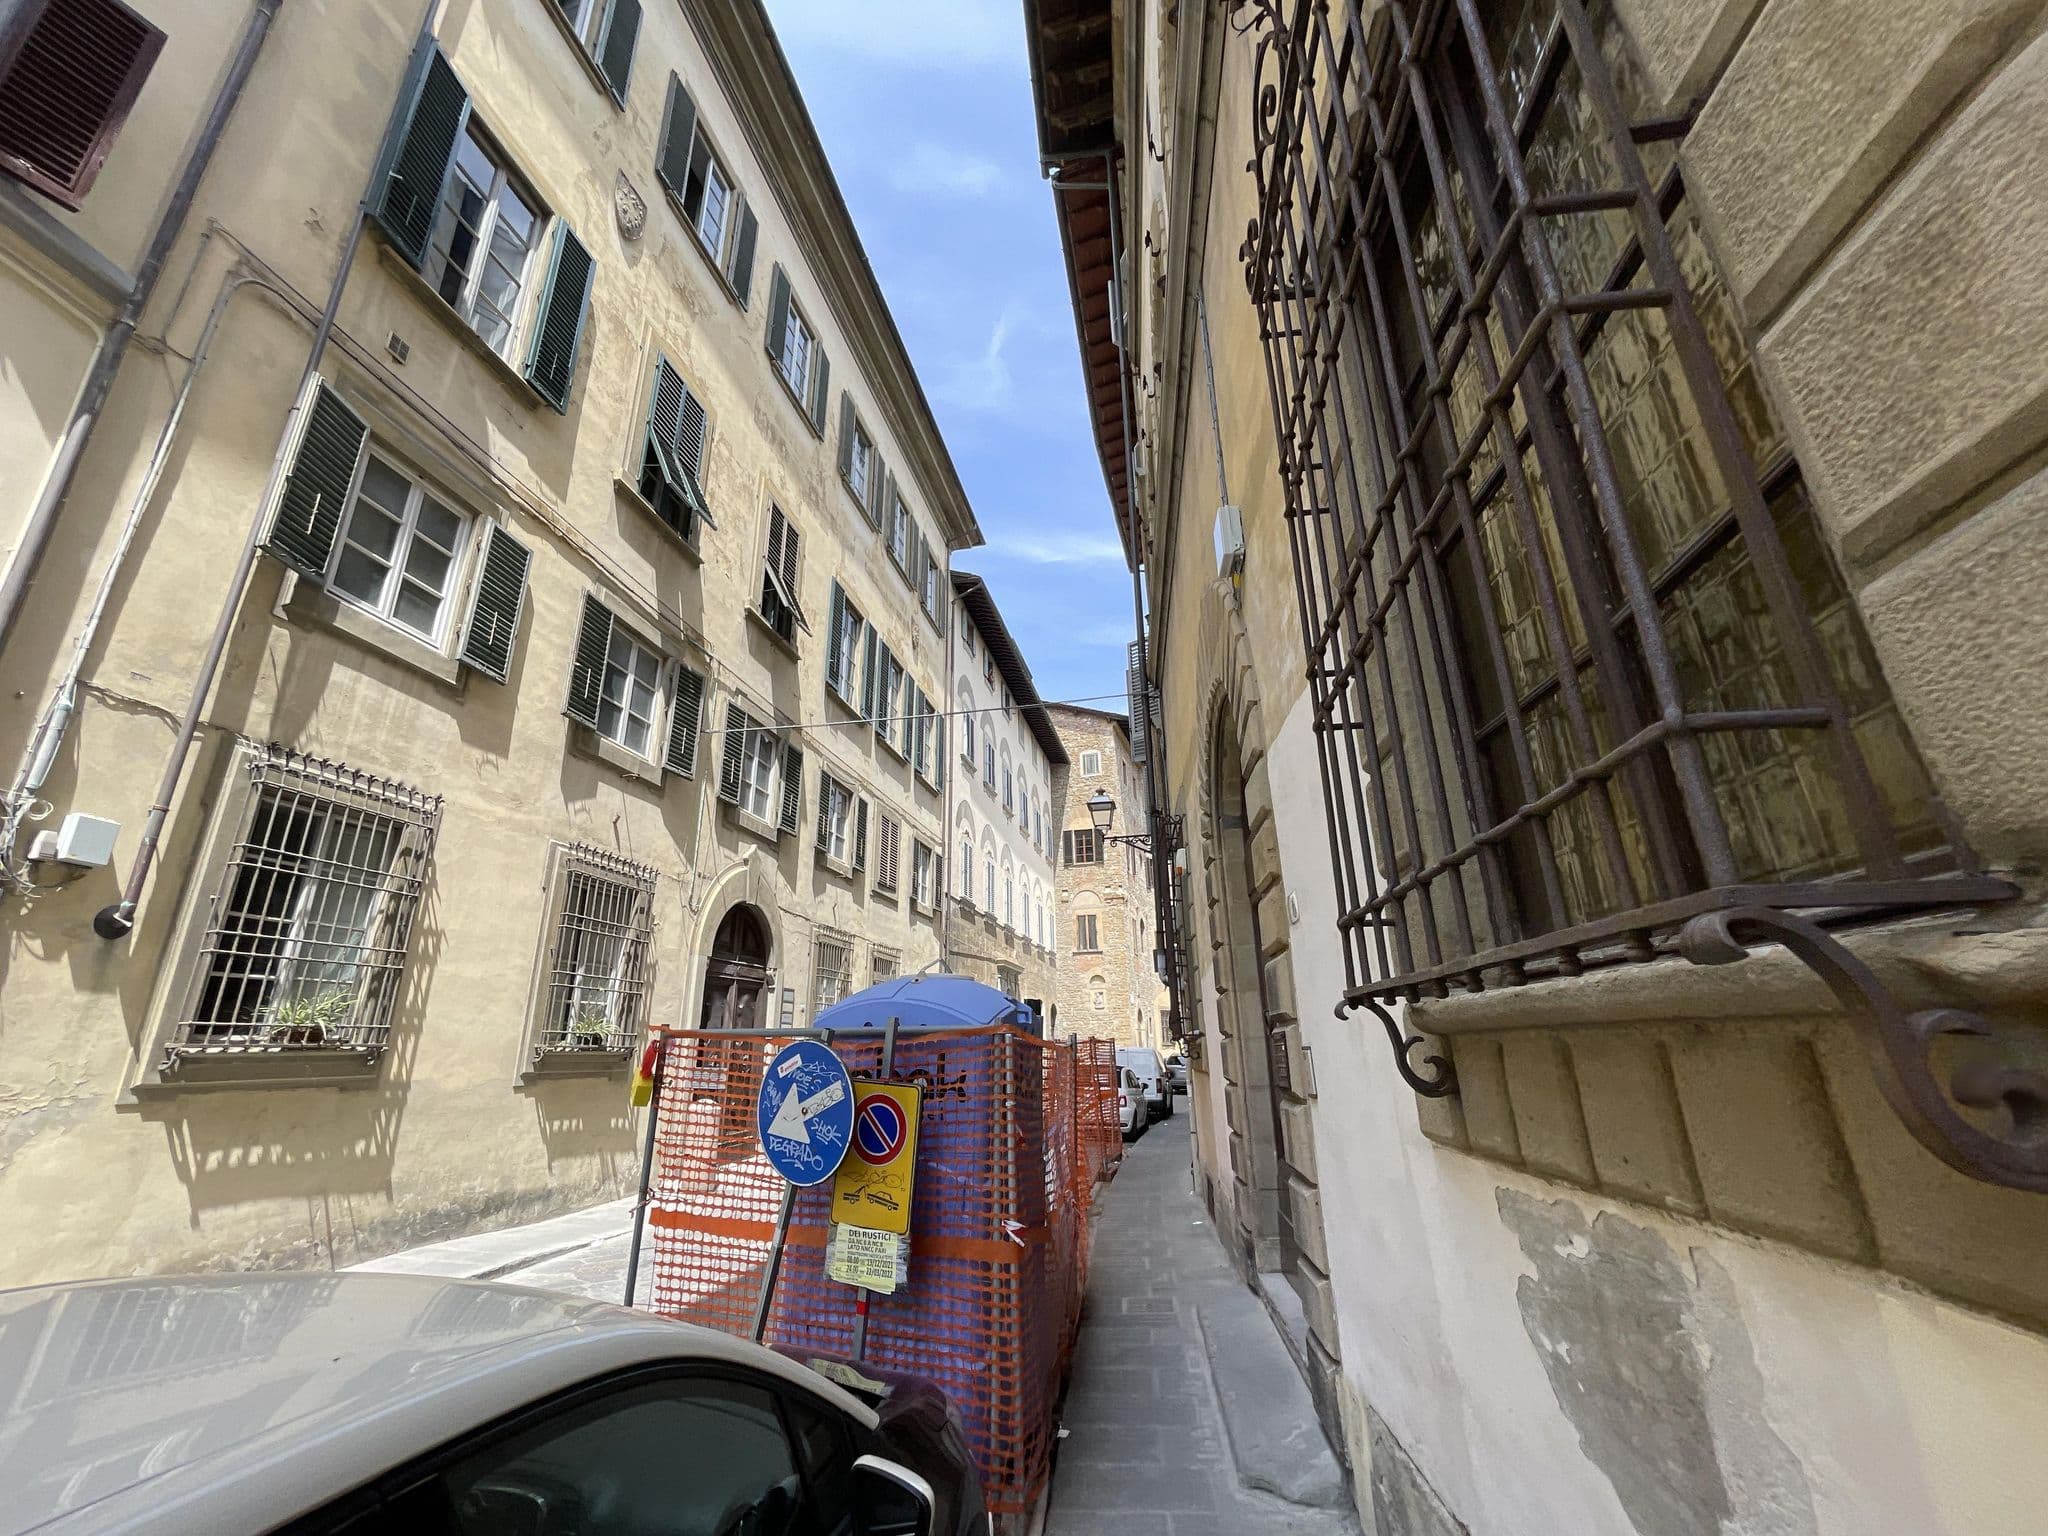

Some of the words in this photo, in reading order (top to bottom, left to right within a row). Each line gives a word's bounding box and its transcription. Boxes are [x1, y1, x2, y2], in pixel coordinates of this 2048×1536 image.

[769, 1136, 824, 1171] DEGRADO
[848, 1229, 861, 1238] DEI
[862, 1231, 891, 1241] RUSTICI
